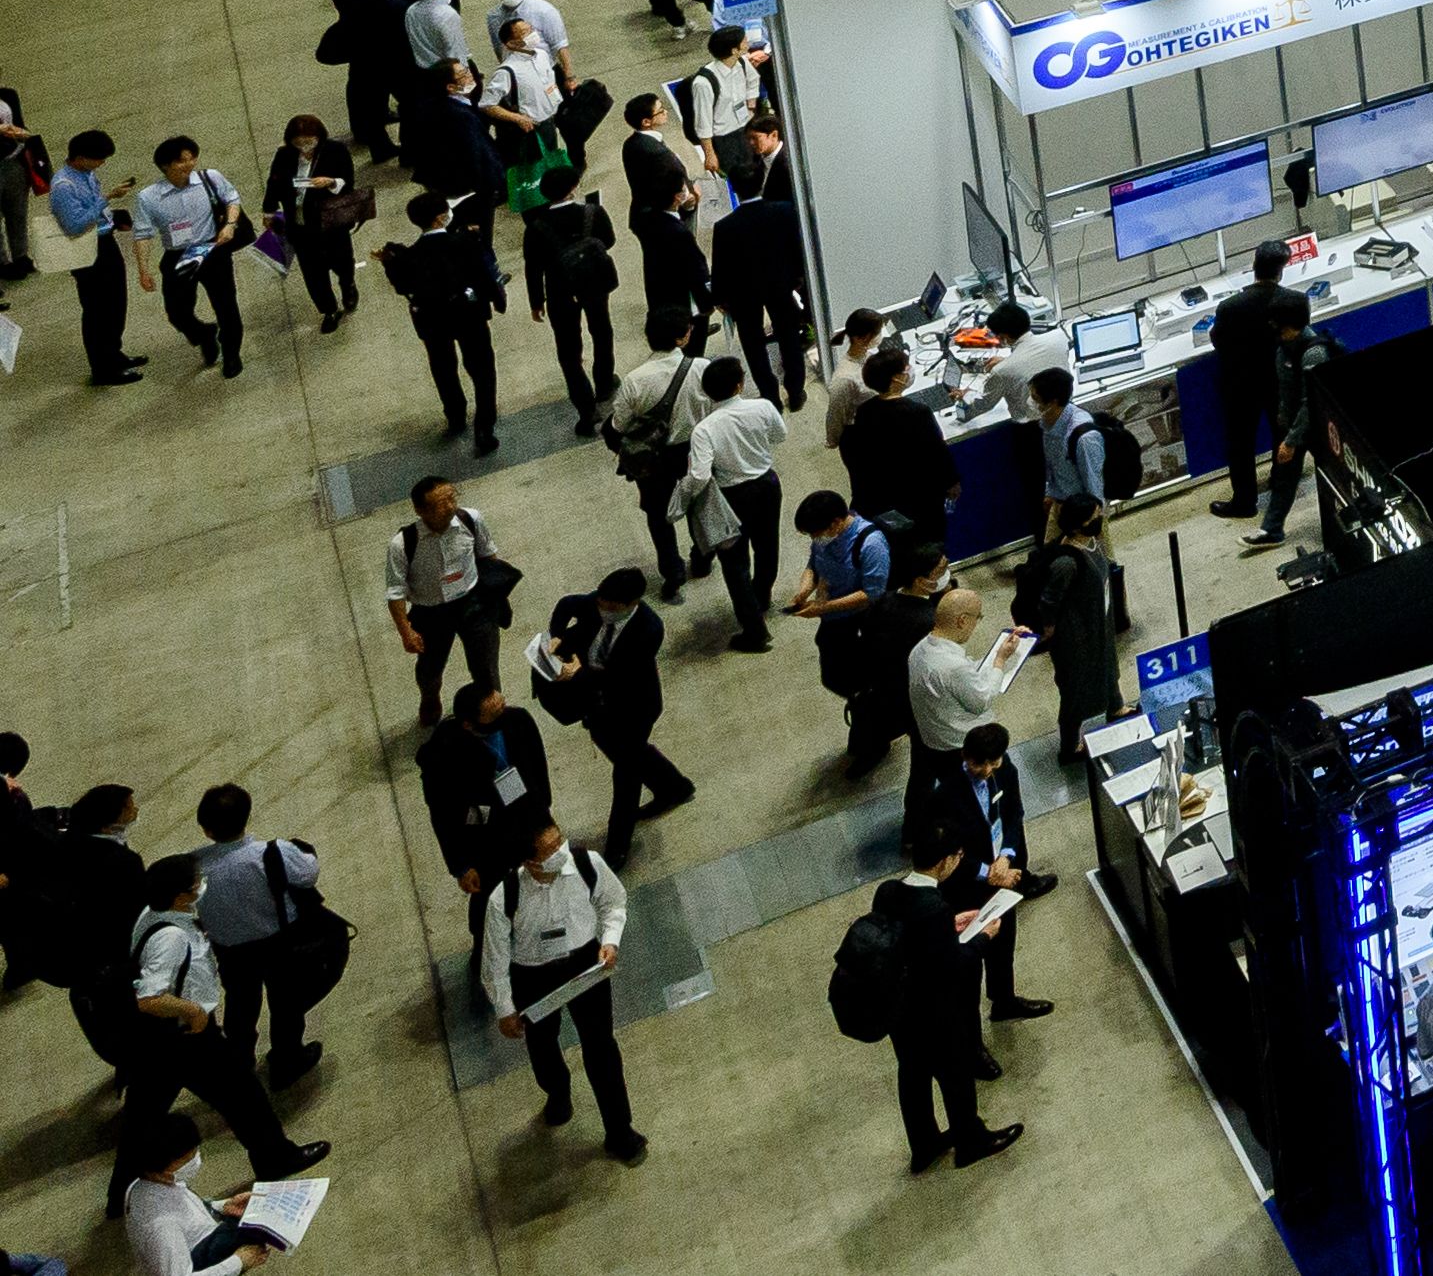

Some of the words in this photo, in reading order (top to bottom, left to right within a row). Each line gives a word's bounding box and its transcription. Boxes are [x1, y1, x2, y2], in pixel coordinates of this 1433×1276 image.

[1126, 13, 1272, 69] OHTEGIKEN
[1128, 26, 1196, 48] MEASUREMENT
[1208, 5, 1268, 27] CALIBRATION
[1146, 649, 1199, 681] 311
